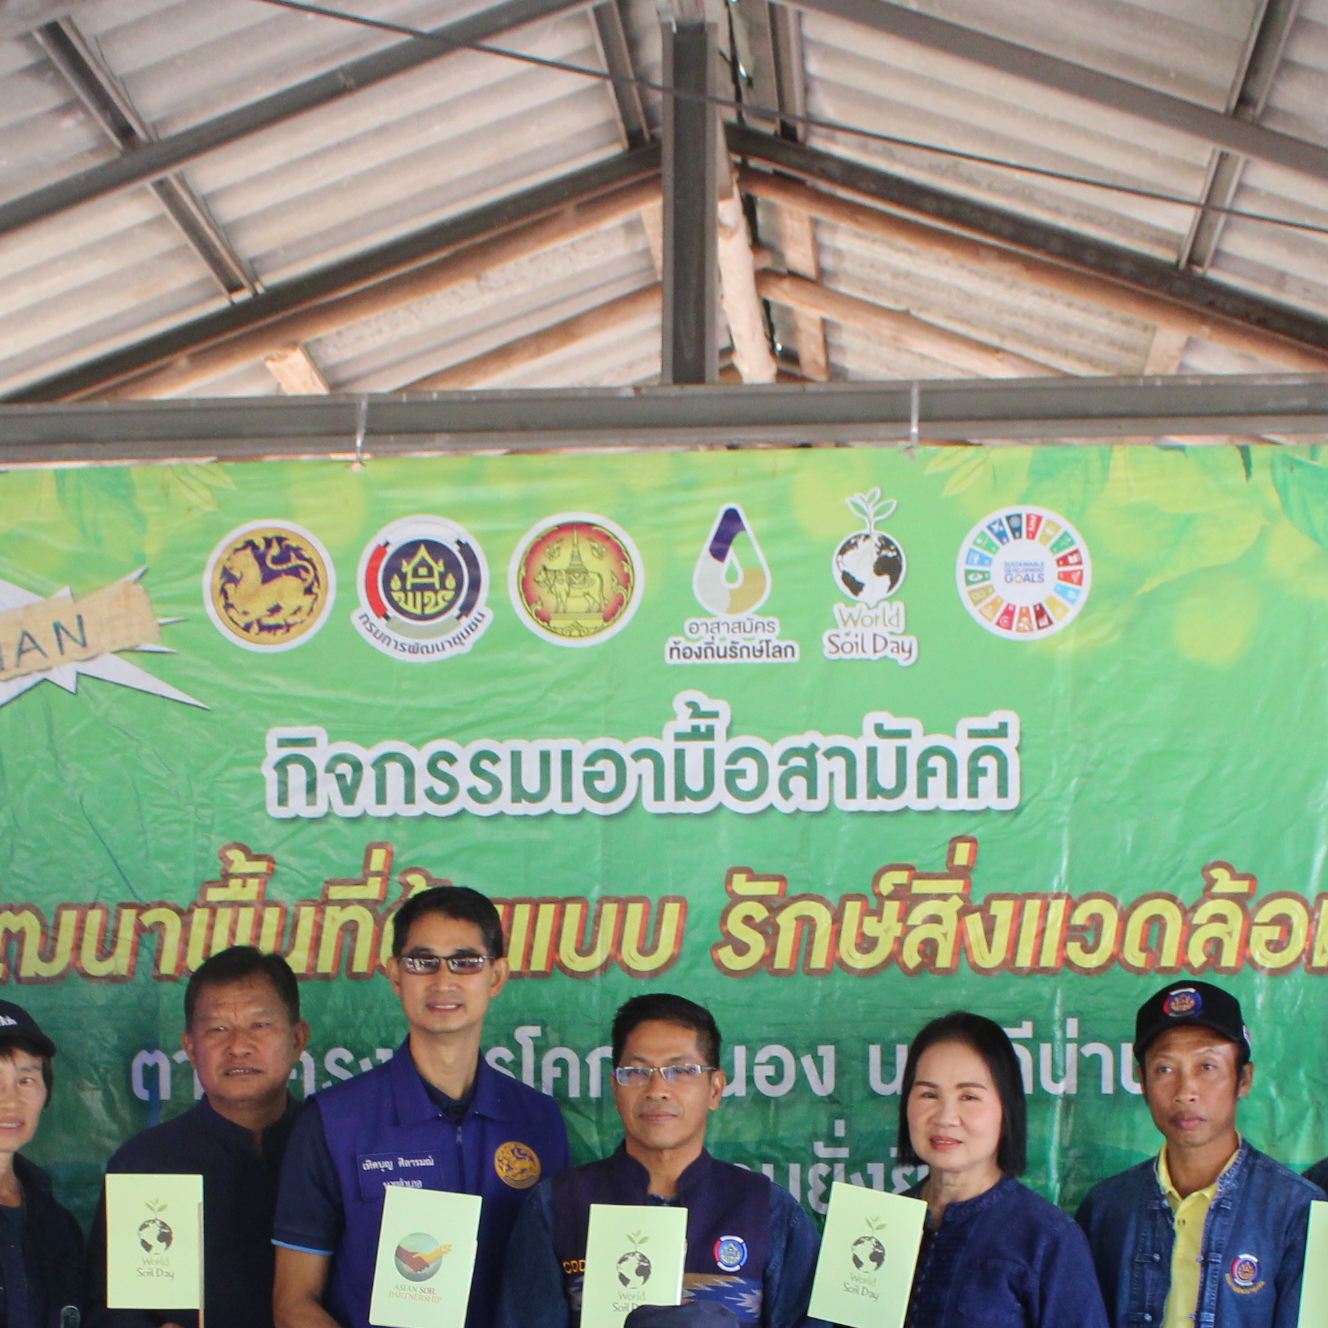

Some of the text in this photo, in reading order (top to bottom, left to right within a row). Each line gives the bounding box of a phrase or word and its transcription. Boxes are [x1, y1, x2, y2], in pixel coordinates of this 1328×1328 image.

[1004, 573, 1045, 583] GOALS
[837, 604, 901, 629] World
[358, 610, 487, 655] กรมการพัฒนาชุมชน
[688, 616, 777, 635] อาสาสมัคร
[669, 636, 796, 661] ท้องถิ่นรักษ์โลก
[827, 632, 913, 661] Soil Day
[272, 702, 1010, 808] กิจกรรมเอามื้อสามัคคี
[141, 1257, 170, 1267] World
[136, 1267, 175, 1280] Soil Day
[849, 1272, 877, 1288] World
[388, 1291, 443, 1304] PARTNERSHIP
[393, 1283, 437, 1296] ASIAN SOIL
[617, 1291, 646, 1301] World
[843, 1282, 879, 1302] Soil Day
[612, 1302, 629, 1313] Soil
